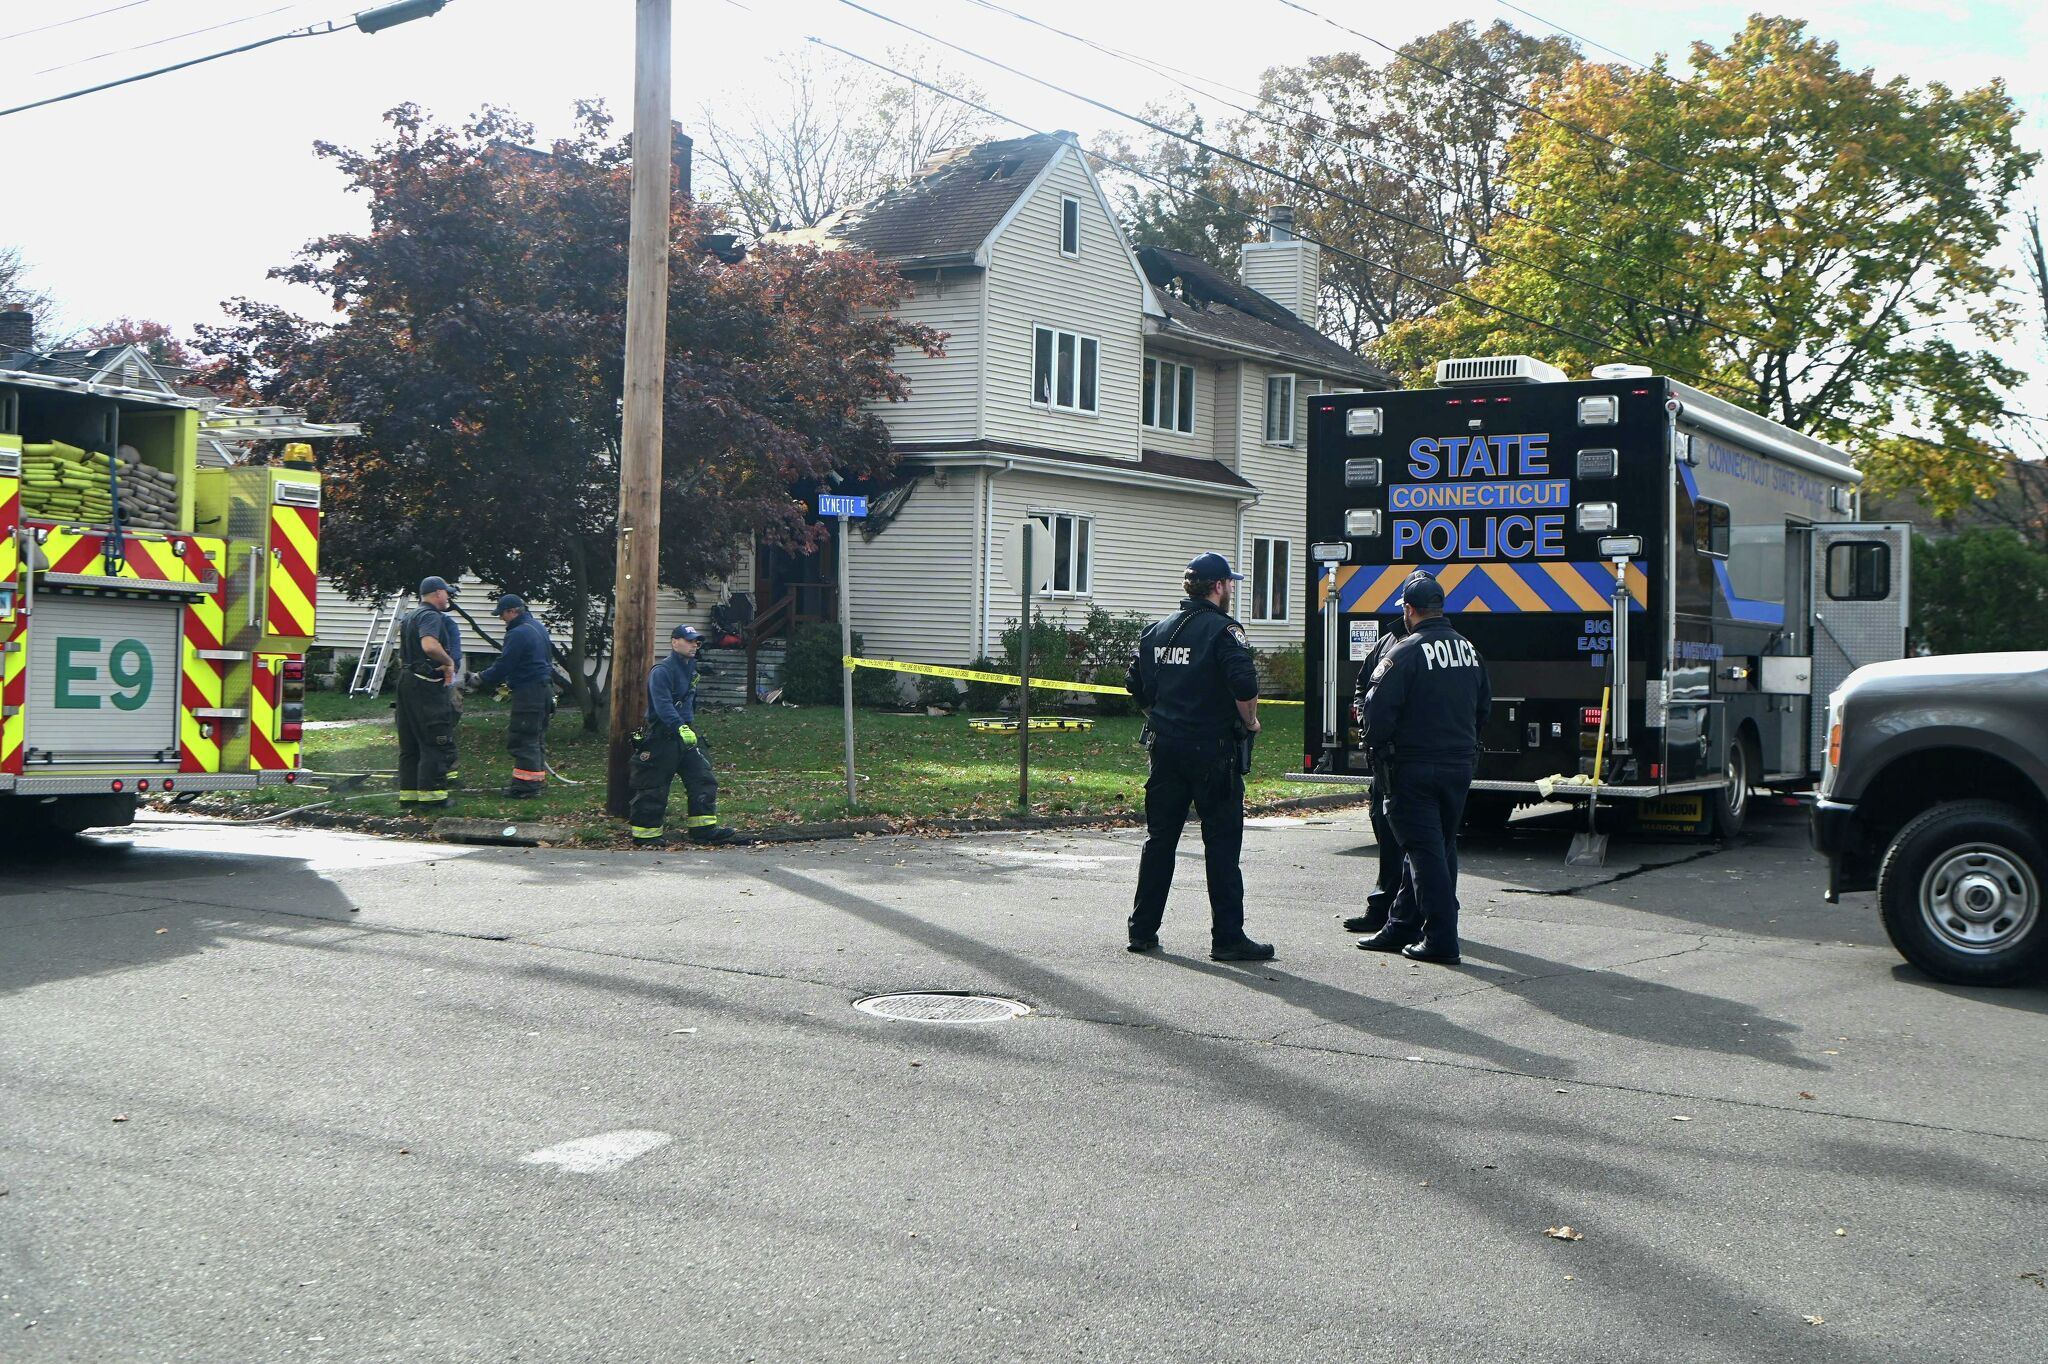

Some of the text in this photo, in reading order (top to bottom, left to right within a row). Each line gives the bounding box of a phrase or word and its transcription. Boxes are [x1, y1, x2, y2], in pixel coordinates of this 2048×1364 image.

[1407, 433, 1550, 480] STATE
[1708, 442, 1824, 505] CONNECTICUT STATE POLICE
[821, 498, 855, 513] LYNETTE
[1392, 483, 1566, 508] CONNECTICUT
[1392, 515, 1566, 560] POLICE
[1351, 630, 1377, 638] REWARD
[1584, 619, 1612, 634] BIG
[1153, 646, 1191, 665] POLICE
[1421, 639, 1480, 671] POLICE
[1577, 636, 1616, 651] EAST
[54, 636, 153, 712] E9
